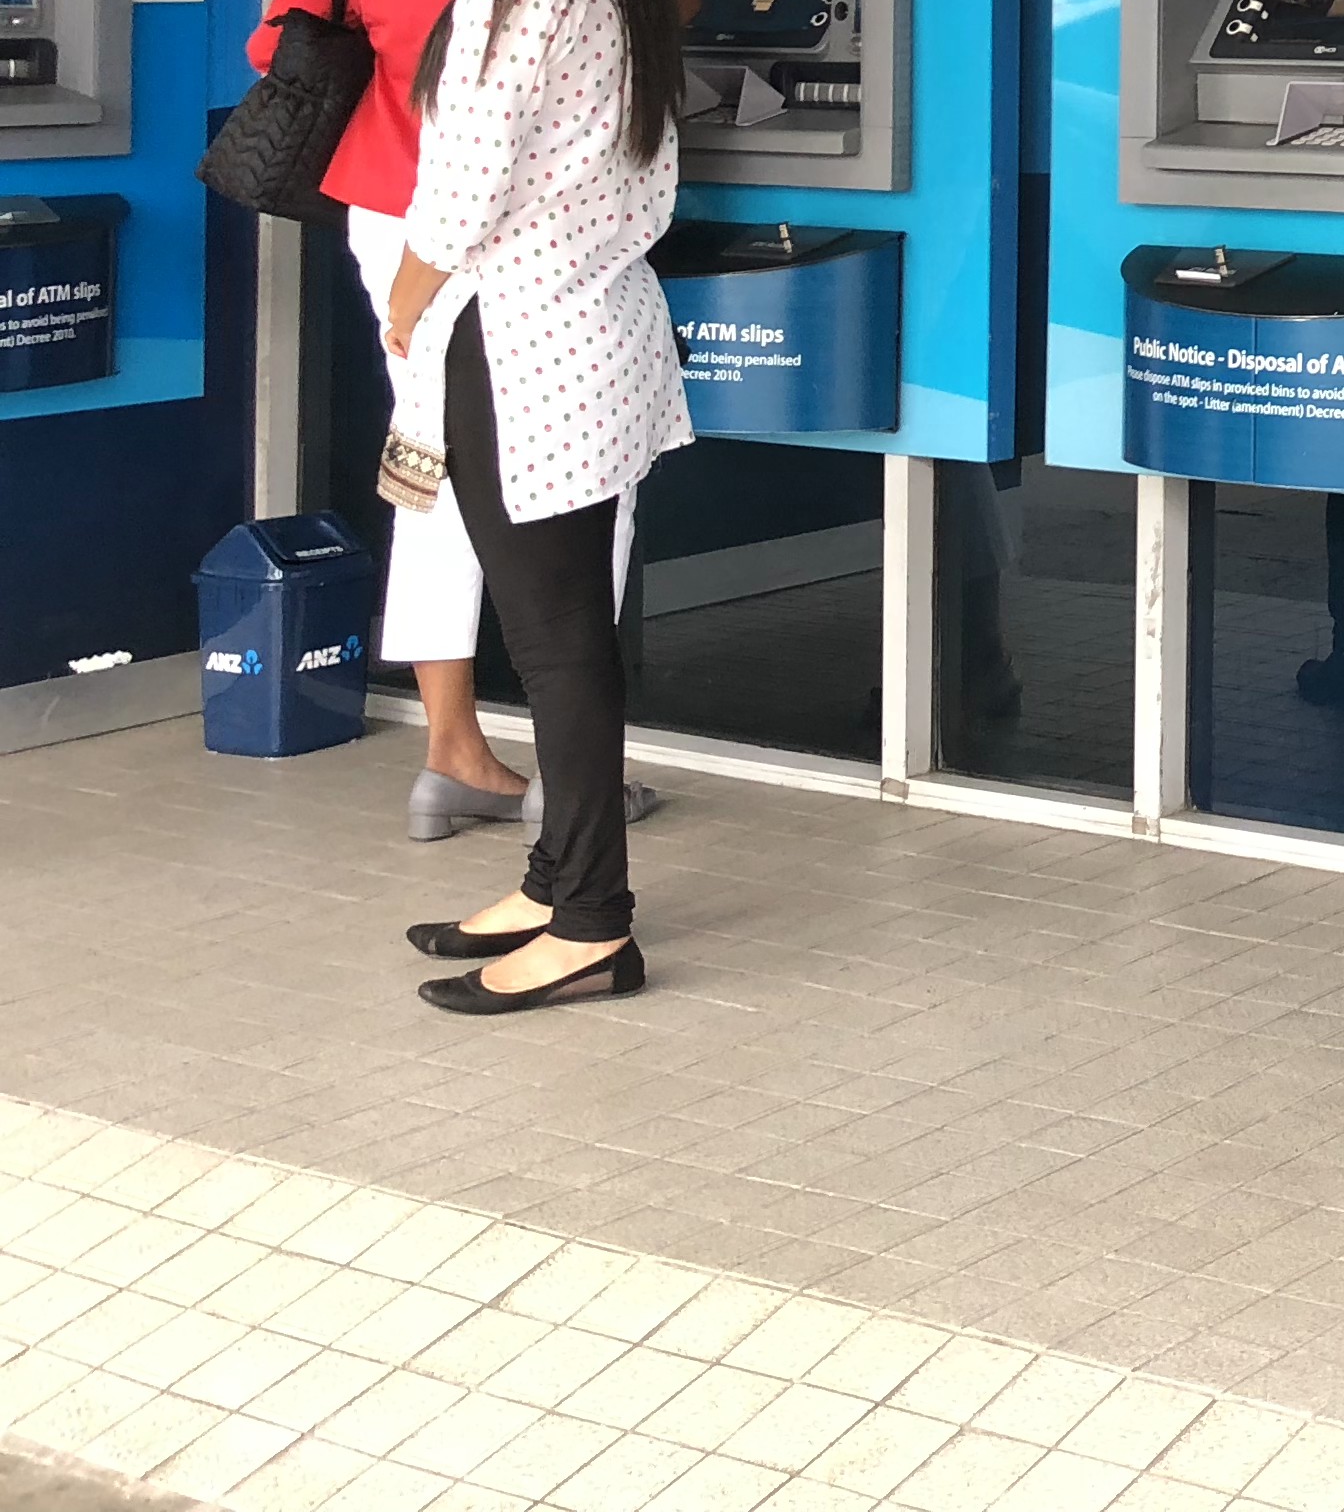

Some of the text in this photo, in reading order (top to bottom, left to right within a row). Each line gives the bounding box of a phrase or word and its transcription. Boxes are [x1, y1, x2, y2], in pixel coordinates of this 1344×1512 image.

[16, 287, 35, 306] of
[37, 284, 71, 304] ATM
[73, 281, 101, 302] slips
[8, 319, 20, 330] to
[677, 321, 785, 347] of ATM slips
[711, 352, 802, 367] being penalised
[1133, 336, 1167, 361] Public
[1169, 341, 1215, 367] Notice
[1227, 348, 1303, 375] Disposal
[1306, 353, 1329, 375] of
[713, 369, 743, 382] 2010.
[1171, 373, 1190, 389] ATM
[1191, 376, 1211, 393] slips
[1212, 379, 1222, 392] in
[1271, 383, 1295, 399] bins
[1297, 386, 1310, 399] to
[1152, 390, 1163, 402] on
[1164, 390, 1177, 404] the
[1179, 395, 1198, 408] spot
[1204, 396, 1230, 412] Litter
[1231, 398, 1303, 419] (amendment)
[205, 651, 242, 675] ANZ
[296, 644, 342, 673] ANZ
